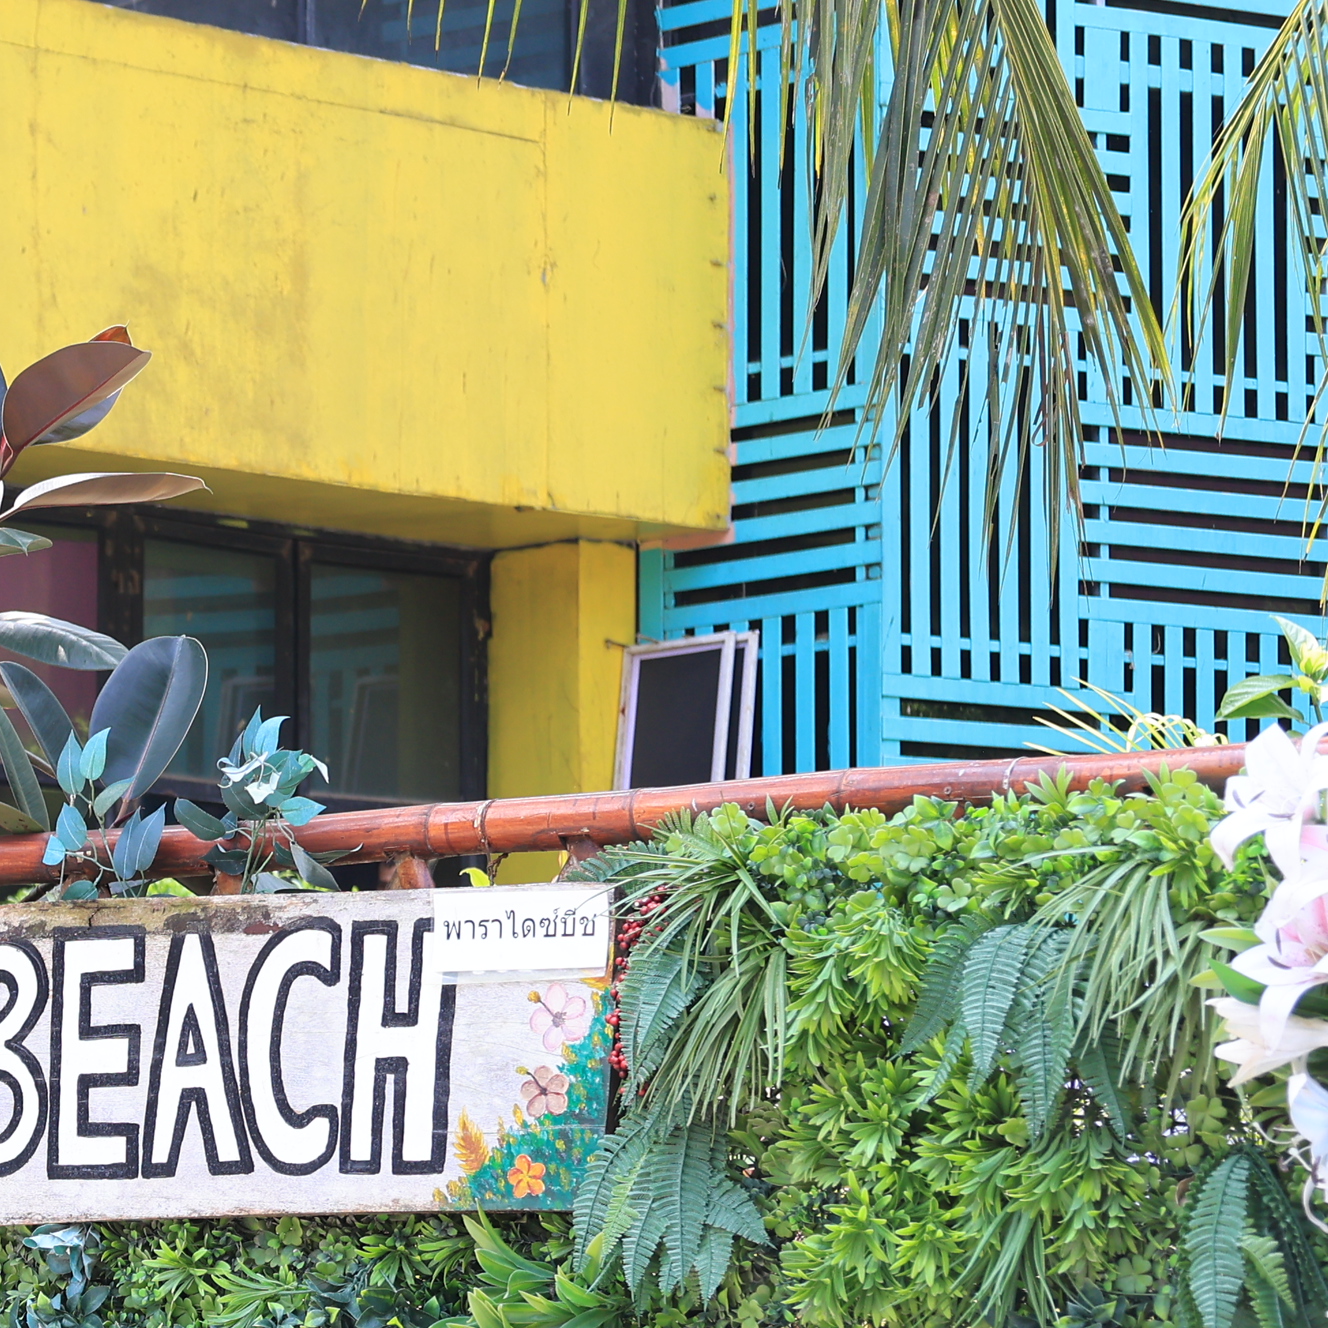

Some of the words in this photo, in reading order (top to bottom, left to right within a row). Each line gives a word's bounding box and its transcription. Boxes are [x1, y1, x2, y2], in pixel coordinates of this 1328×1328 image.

[443, 907, 597, 941] พาราไดซ์บีช
